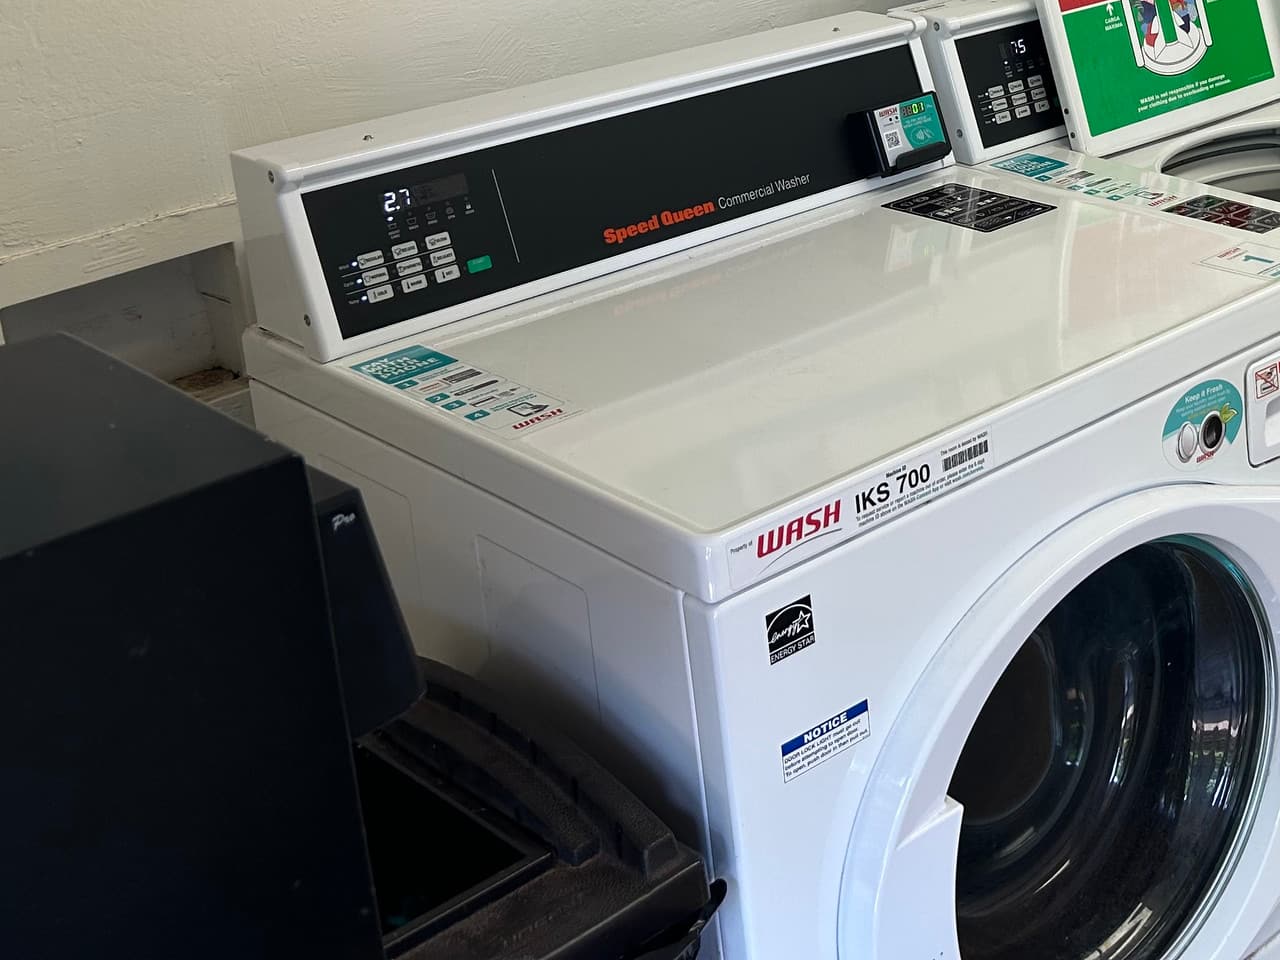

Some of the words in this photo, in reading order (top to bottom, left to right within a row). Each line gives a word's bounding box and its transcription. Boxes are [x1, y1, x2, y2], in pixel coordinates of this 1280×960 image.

[1010, 38, 1027, 54] 75
[718, 183, 774, 209] Commercial
[774, 173, 811, 193] Washer
[603, 215, 660, 244] Speed
[660, 200, 716, 226] Queen
[1184, 391, 1200, 404] Keep
[1205, 383, 1223, 396] Fresh
[511, 407, 564, 431] WASH
[854, 481, 891, 514] IKS
[895, 463, 931, 493] 700
[756, 499, 842, 559] WASH
[770, 643, 798, 664] ENERGY
[797, 634, 816, 651] STAR
[803, 711, 849, 744] NOTICE
